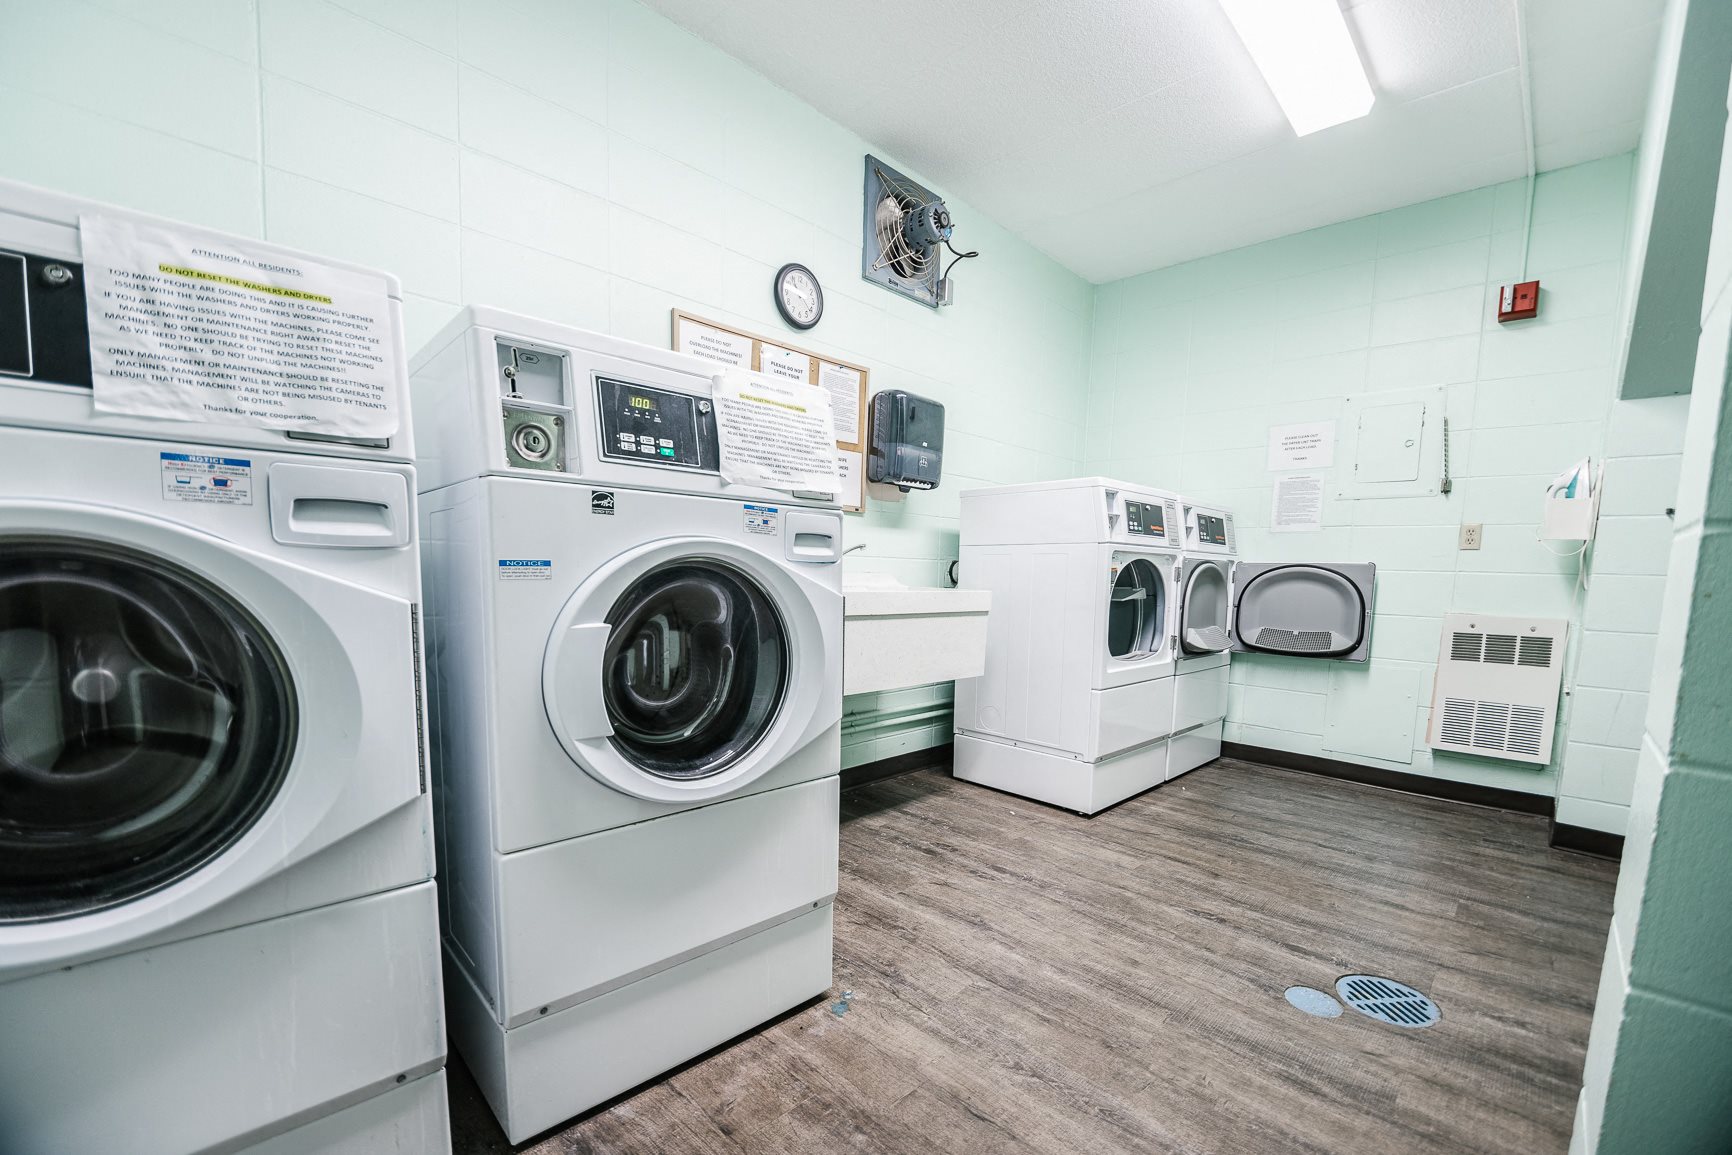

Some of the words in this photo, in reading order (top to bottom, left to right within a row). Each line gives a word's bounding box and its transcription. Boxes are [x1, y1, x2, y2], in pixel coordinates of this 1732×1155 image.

[192, 249, 240, 263] ATTENTION
[242, 259, 256, 267] ALL
[259, 262, 304, 277] RESIDENTS:
[109, 269, 129, 278] TOO
[132, 273, 161, 283] MANY
[164, 279, 196, 290] PEOPLE
[199, 285, 216, 293] ARE
[219, 288, 247, 299] DOING
[249, 295, 266, 304] THIS
[306, 305, 340, 317] CAUSING
[342, 312, 374, 323] FURTHER
[114, 280, 146, 291] ISSUES
[149, 286, 174, 296] WITH
[196, 295, 237, 307] WASHERS
[240, 302, 258, 311] AND
[260, 306, 290, 317] DRYERS
[292, 312, 330, 324] WORKING
[159, 265, 172, 273] DO
[175, 269, 194, 277] NOT
[197, 273, 222, 281] RESET
[225, 276, 240, 286] THE
[242, 282, 282, 295] WASHERS
[284, 290, 301, 298] AND
[303, 294, 332, 304] DRYERS
[115, 293, 136, 302] YOU
[138, 298, 156, 306] ARE
[160, 301, 195, 312] HAVING
[198, 308, 227, 317] ISSUES
[229, 311, 251, 322] WITH
[271, 320, 315, 333] MACHINES,
[317, 328, 343, 337] PLEASE
[344, 332, 366, 341] COME
[119, 304, 188, 321] MANAGEMENT
[191, 315, 204, 323] OR
[206, 317, 268, 334] MAINTENANCE
[271, 330, 294, 339] RIGHT
[296, 334, 321, 342] AWAY
[322, 337, 333, 345] TO
[334, 339, 356, 349] RESET
[119, 325, 131, 333] AS
[134, 327, 149, 335] WE
[152, 330, 177, 340] NEED
[179, 334, 191, 342] TO
[194, 336, 215, 345] KEEP
[218, 339, 245, 349] TRACK
[260, 347, 275, 355] THE
[276, 350, 319, 361] MACHINES
[321, 355, 337, 363] NOT
[339, 359, 374, 370] WORKING
[163, 322, 178, 330] NO
[180, 324, 199, 333] ONE
[201, 327, 237, 339] SHOULD
[240, 334, 249, 342] BE
[252, 336, 281, 347] TRYING
[283, 341, 294, 349] TO
[296, 344, 319, 352] RESET
[321, 346, 343, 355] THESE
[345, 349, 384, 363] MACHINES
[211, 349, 225, 357] DO
[227, 351, 245, 359] NOT
[247, 354, 281, 366] UNPLUG
[108, 347, 135, 357] ONLY
[137, 351, 205, 367] MANAGEMENT
[223, 363, 283, 379] MAINTENANCE
[286, 373, 318, 382] SHOULD
[331, 378, 370, 390] RESETTING
[171, 366, 237, 380] MANAGEMENT
[239, 377, 259, 385] WILL
[273, 381, 317, 391] WATCHING
[335, 387, 370, 399] CAMERAS
[771, 361, 786, 370] PLEASE
[110, 369, 147, 380] ENSURE
[151, 374, 174, 383] THAT
[177, 377, 194, 386] THE
[196, 381, 242, 392] MACHINES
[262, 389, 279, 397] NOT
[281, 391, 306, 399] BEING
[308, 394, 342, 403] MISUSED
[355, 400, 387, 410] TENANTS
[237, 395, 250, 403] OR
[631, 397, 650, 409] 100
[203, 404, 233, 414] Thanks
[235, 405, 247, 414] for
[269, 412, 319, 421] cooperation.
[188, 455, 225, 464] NOTICE
